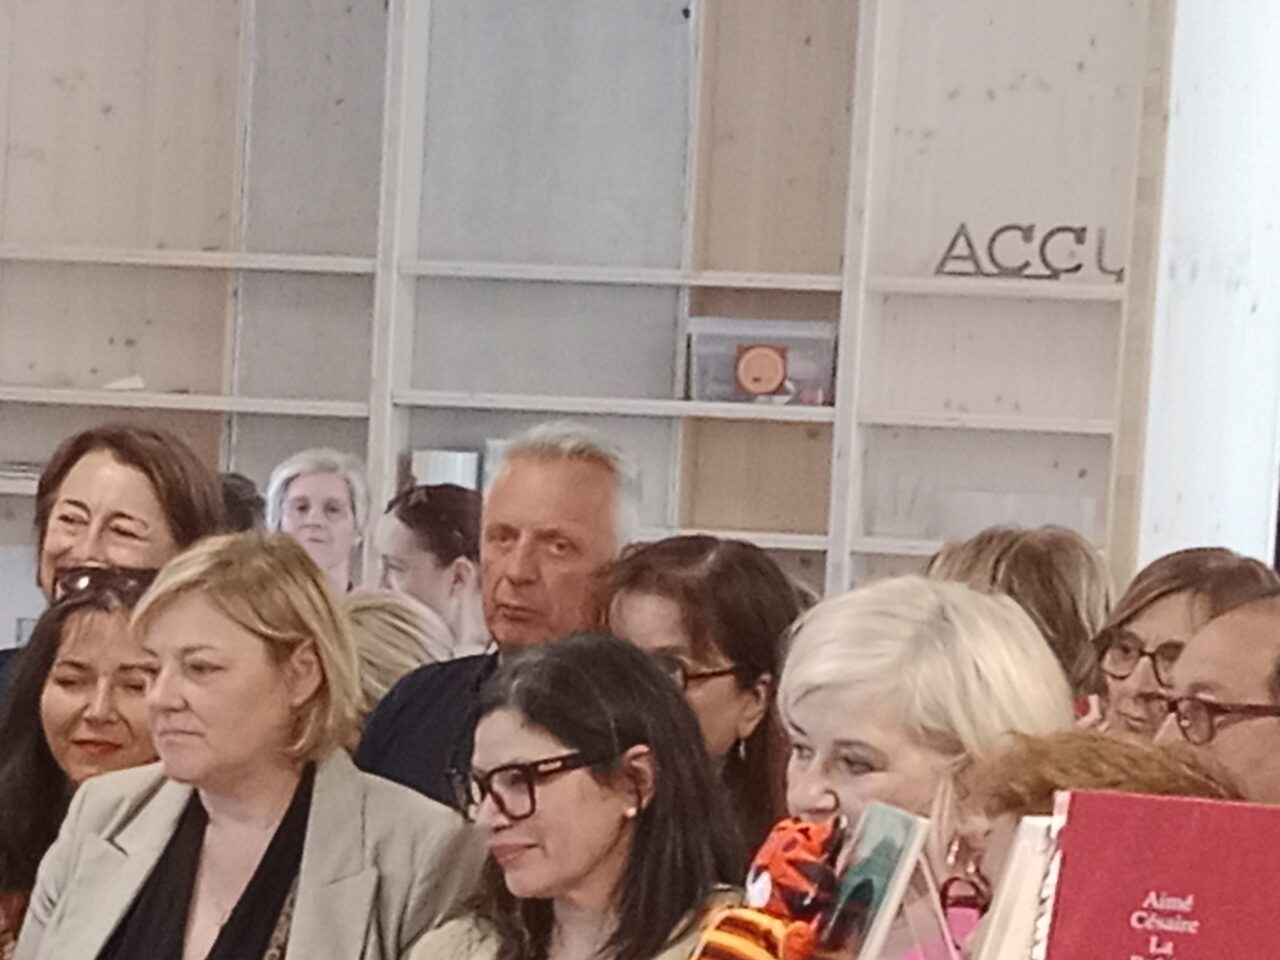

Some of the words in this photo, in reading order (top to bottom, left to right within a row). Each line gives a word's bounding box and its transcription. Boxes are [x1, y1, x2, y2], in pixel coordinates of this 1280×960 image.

[1142, 891, 1194, 912] Aimé
[1130, 911, 1200, 934] Césaire
[1149, 935, 1174, 955] La
